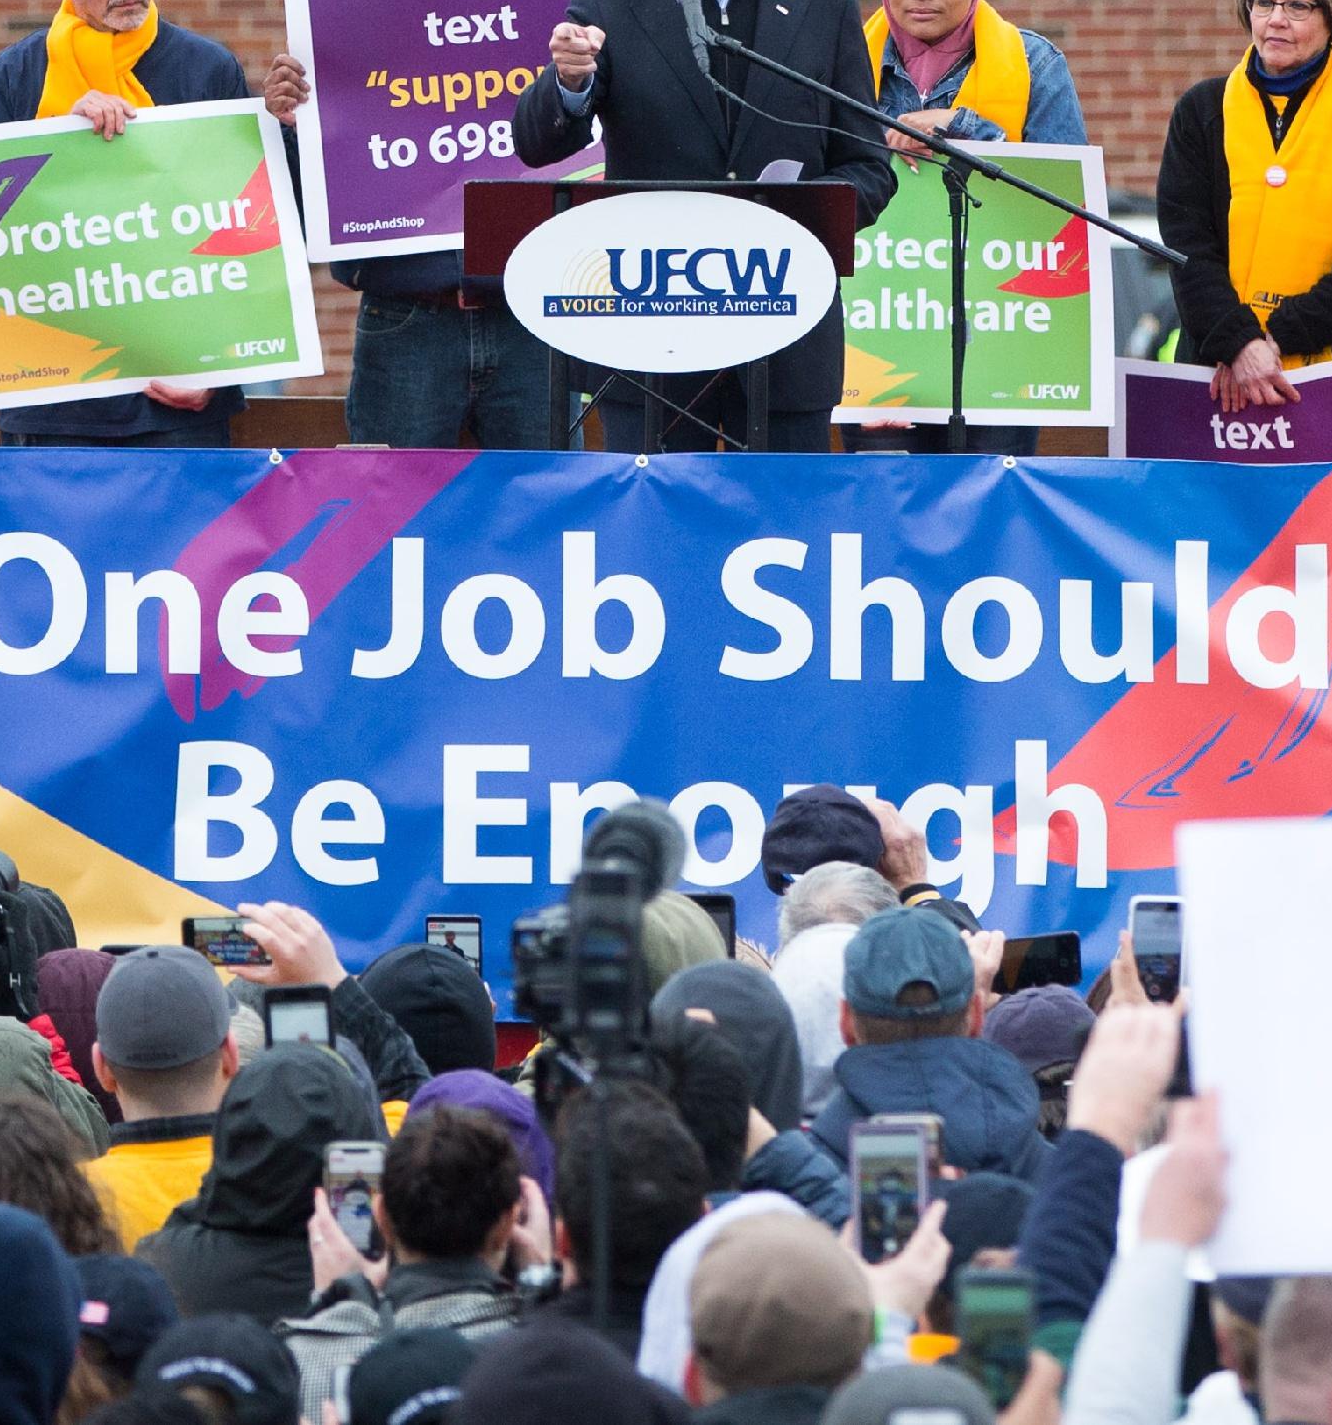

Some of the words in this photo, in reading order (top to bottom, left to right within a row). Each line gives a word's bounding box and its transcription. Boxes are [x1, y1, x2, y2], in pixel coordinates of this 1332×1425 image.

[423, 5, 519, 46] text
[366, 64, 546, 113] “suppo
[368, 133, 418, 170] to
[171, 196, 252, 236] our
[342, 216, 425, 234] #StopAndShop
[604, 247, 792, 298] UFCW
[982, 238, 1066, 271] our
[548, 301, 559, 314] a
[561, 298, 616, 314] VOICE
[620, 297, 646, 314] for
[650, 298, 719, 315] working
[723, 298, 792, 313] America
[844, 287, 1052, 333] althare
[234, 337, 286, 359] UFCW
[1028, 383, 1081, 400] UFCW
[1209, 413, 1295, 450] text
[351, 530, 667, 680] Job
[718, 531, 1329, 690] Should
[173, 739, 387, 887] Be
[441, 739, 1109, 917] Enogh
